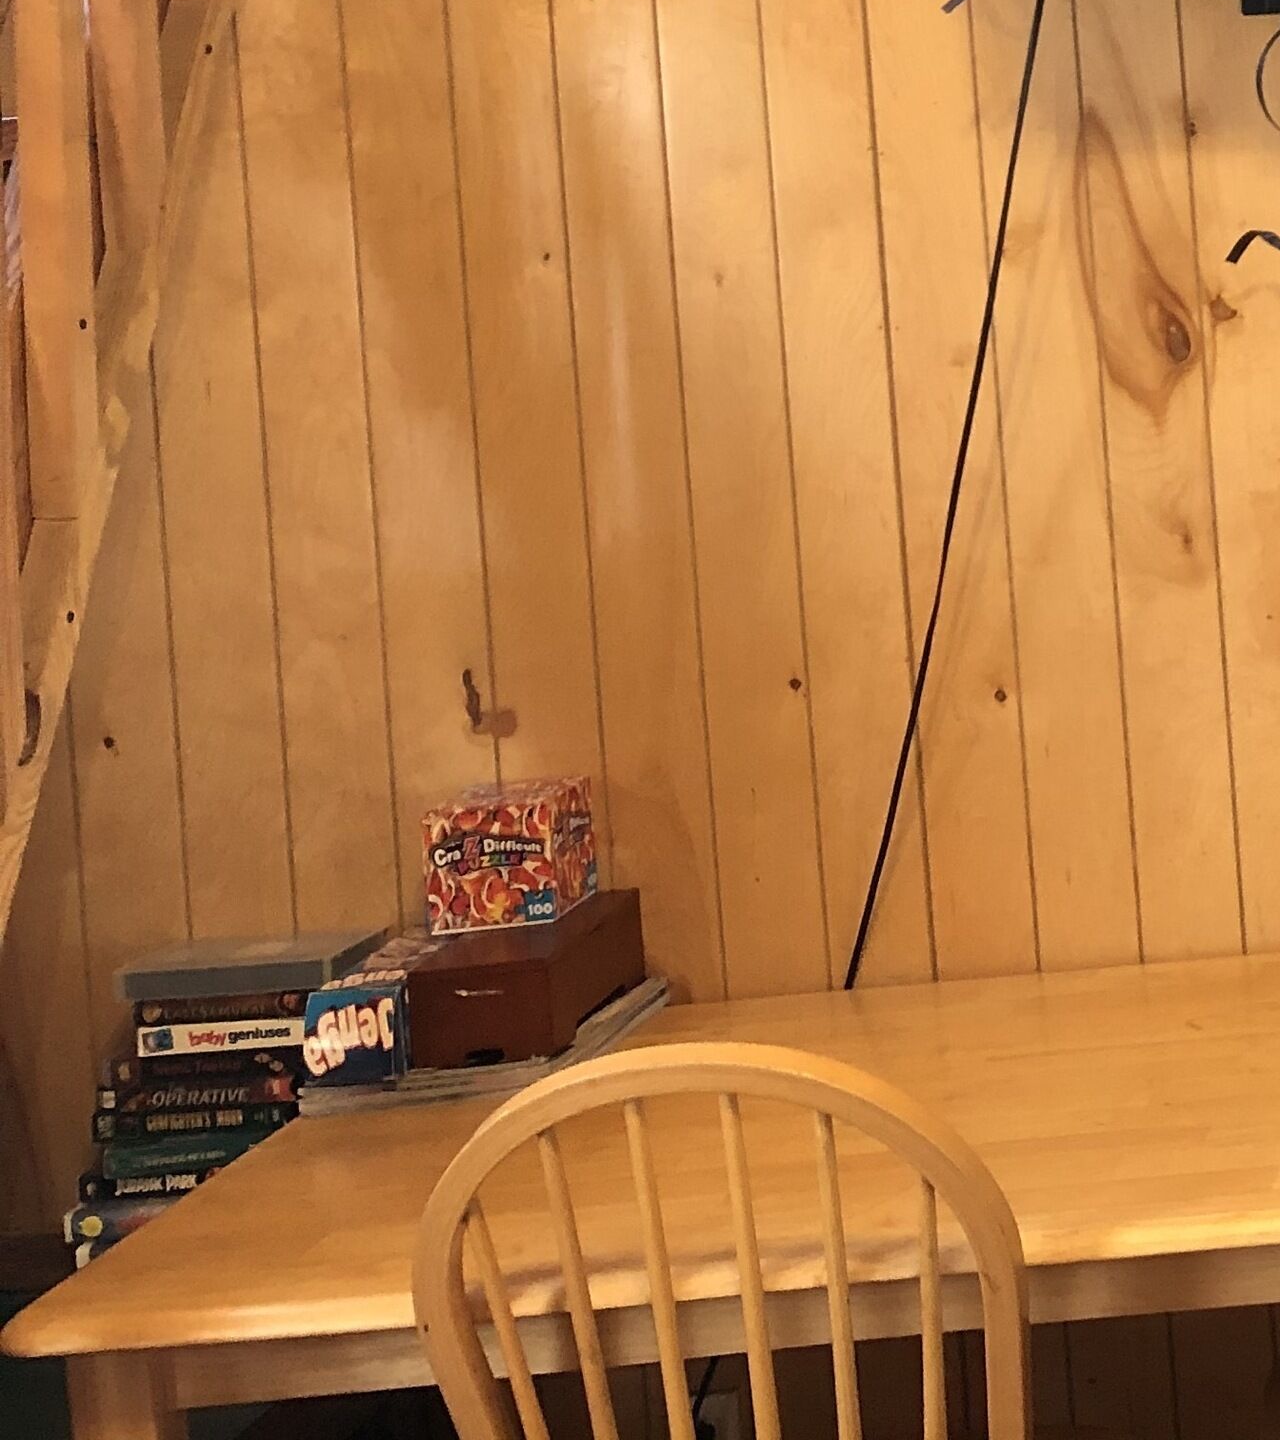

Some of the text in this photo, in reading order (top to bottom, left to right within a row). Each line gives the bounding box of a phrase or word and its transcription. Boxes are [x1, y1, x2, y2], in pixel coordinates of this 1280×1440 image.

[527, 903, 553, 915] 100
[187, 1026, 291, 1047] baby geniuses
[303, 998, 394, 1076] Jenga
[151, 1086, 249, 1107] OPERATIVE
